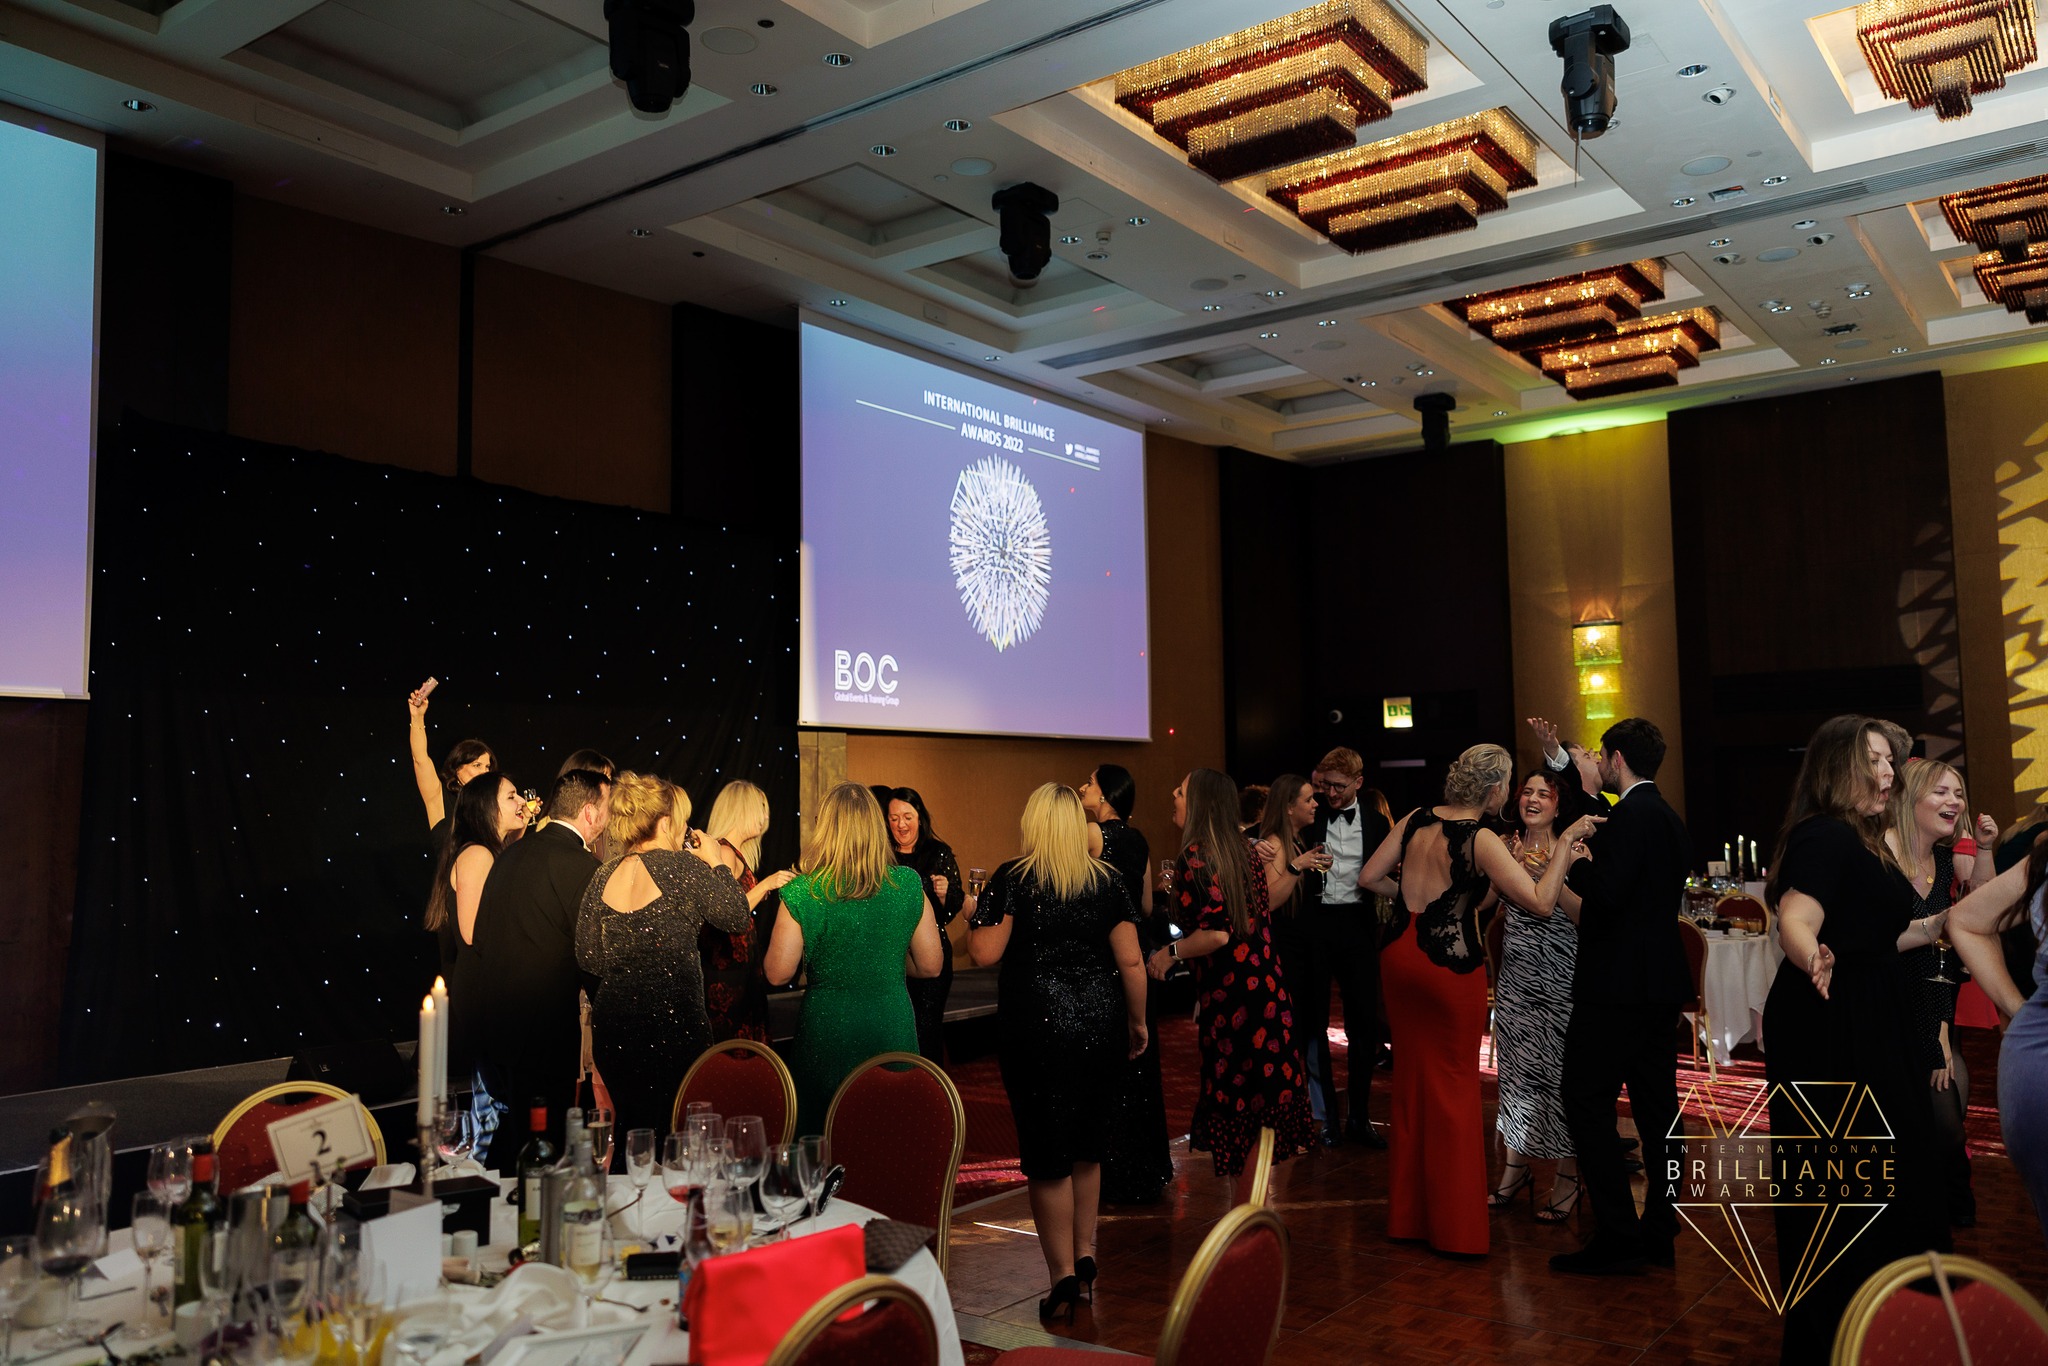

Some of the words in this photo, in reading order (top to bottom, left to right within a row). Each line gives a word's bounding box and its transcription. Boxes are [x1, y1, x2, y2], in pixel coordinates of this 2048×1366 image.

[923, 389, 1002, 426] INTERNATIONAL
[1003, 414, 1055, 442] BRILLIANCE
[960, 422, 1002, 447] AWARDS
[1002, 434, 1024, 453] 2022
[835, 649, 899, 694] BOC
[312, 1129, 331, 1156] 2
